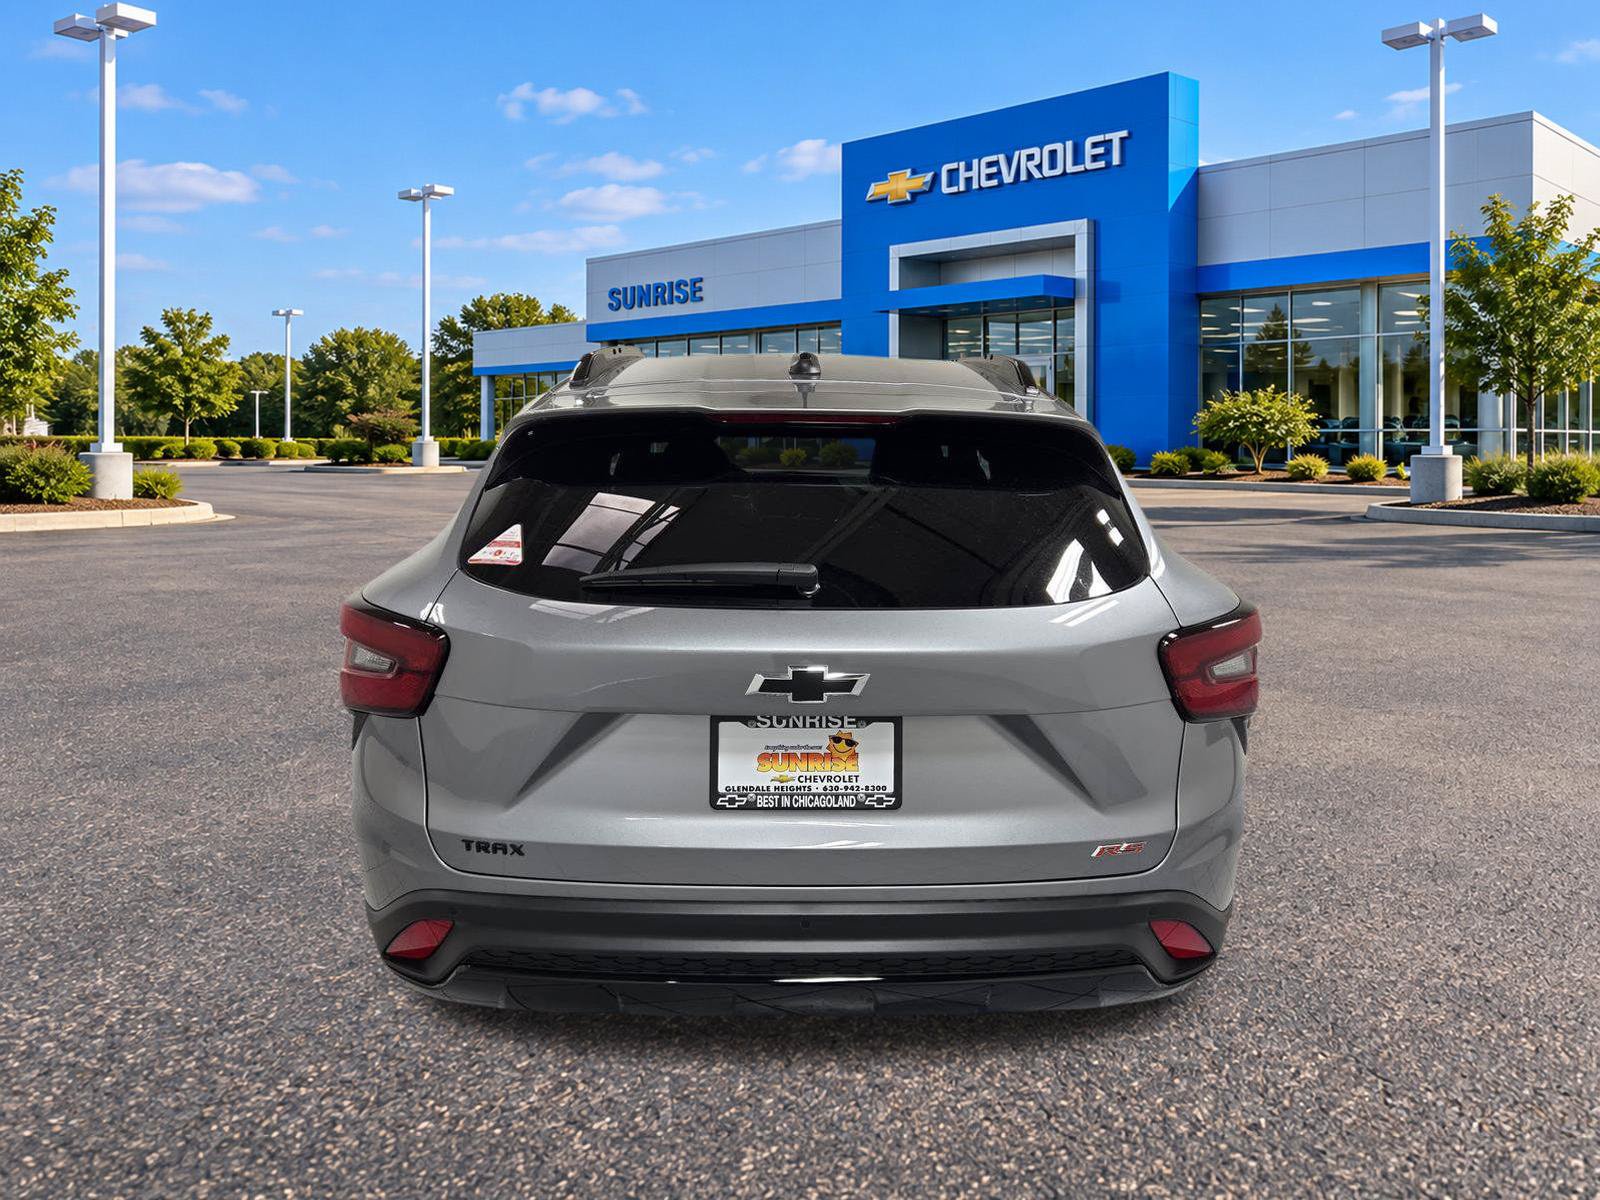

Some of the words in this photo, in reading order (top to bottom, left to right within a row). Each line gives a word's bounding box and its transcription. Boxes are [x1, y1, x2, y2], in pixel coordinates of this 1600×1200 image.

[940, 130, 1130, 194] CHEVROLET
[607, 276, 705, 312] SUNRISE
[756, 715, 857, 729] SUNRISE
[757, 752, 860, 772] SUNRISE
[797, 774, 860, 784] CHEVROLET
[756, 795, 780, 808] BEST
[781, 795, 791, 808] IN
[792, 795, 857, 808] CHICAGOLAND
[461, 838, 525, 856] TRAX
[1091, 841, 1146, 857] RS
